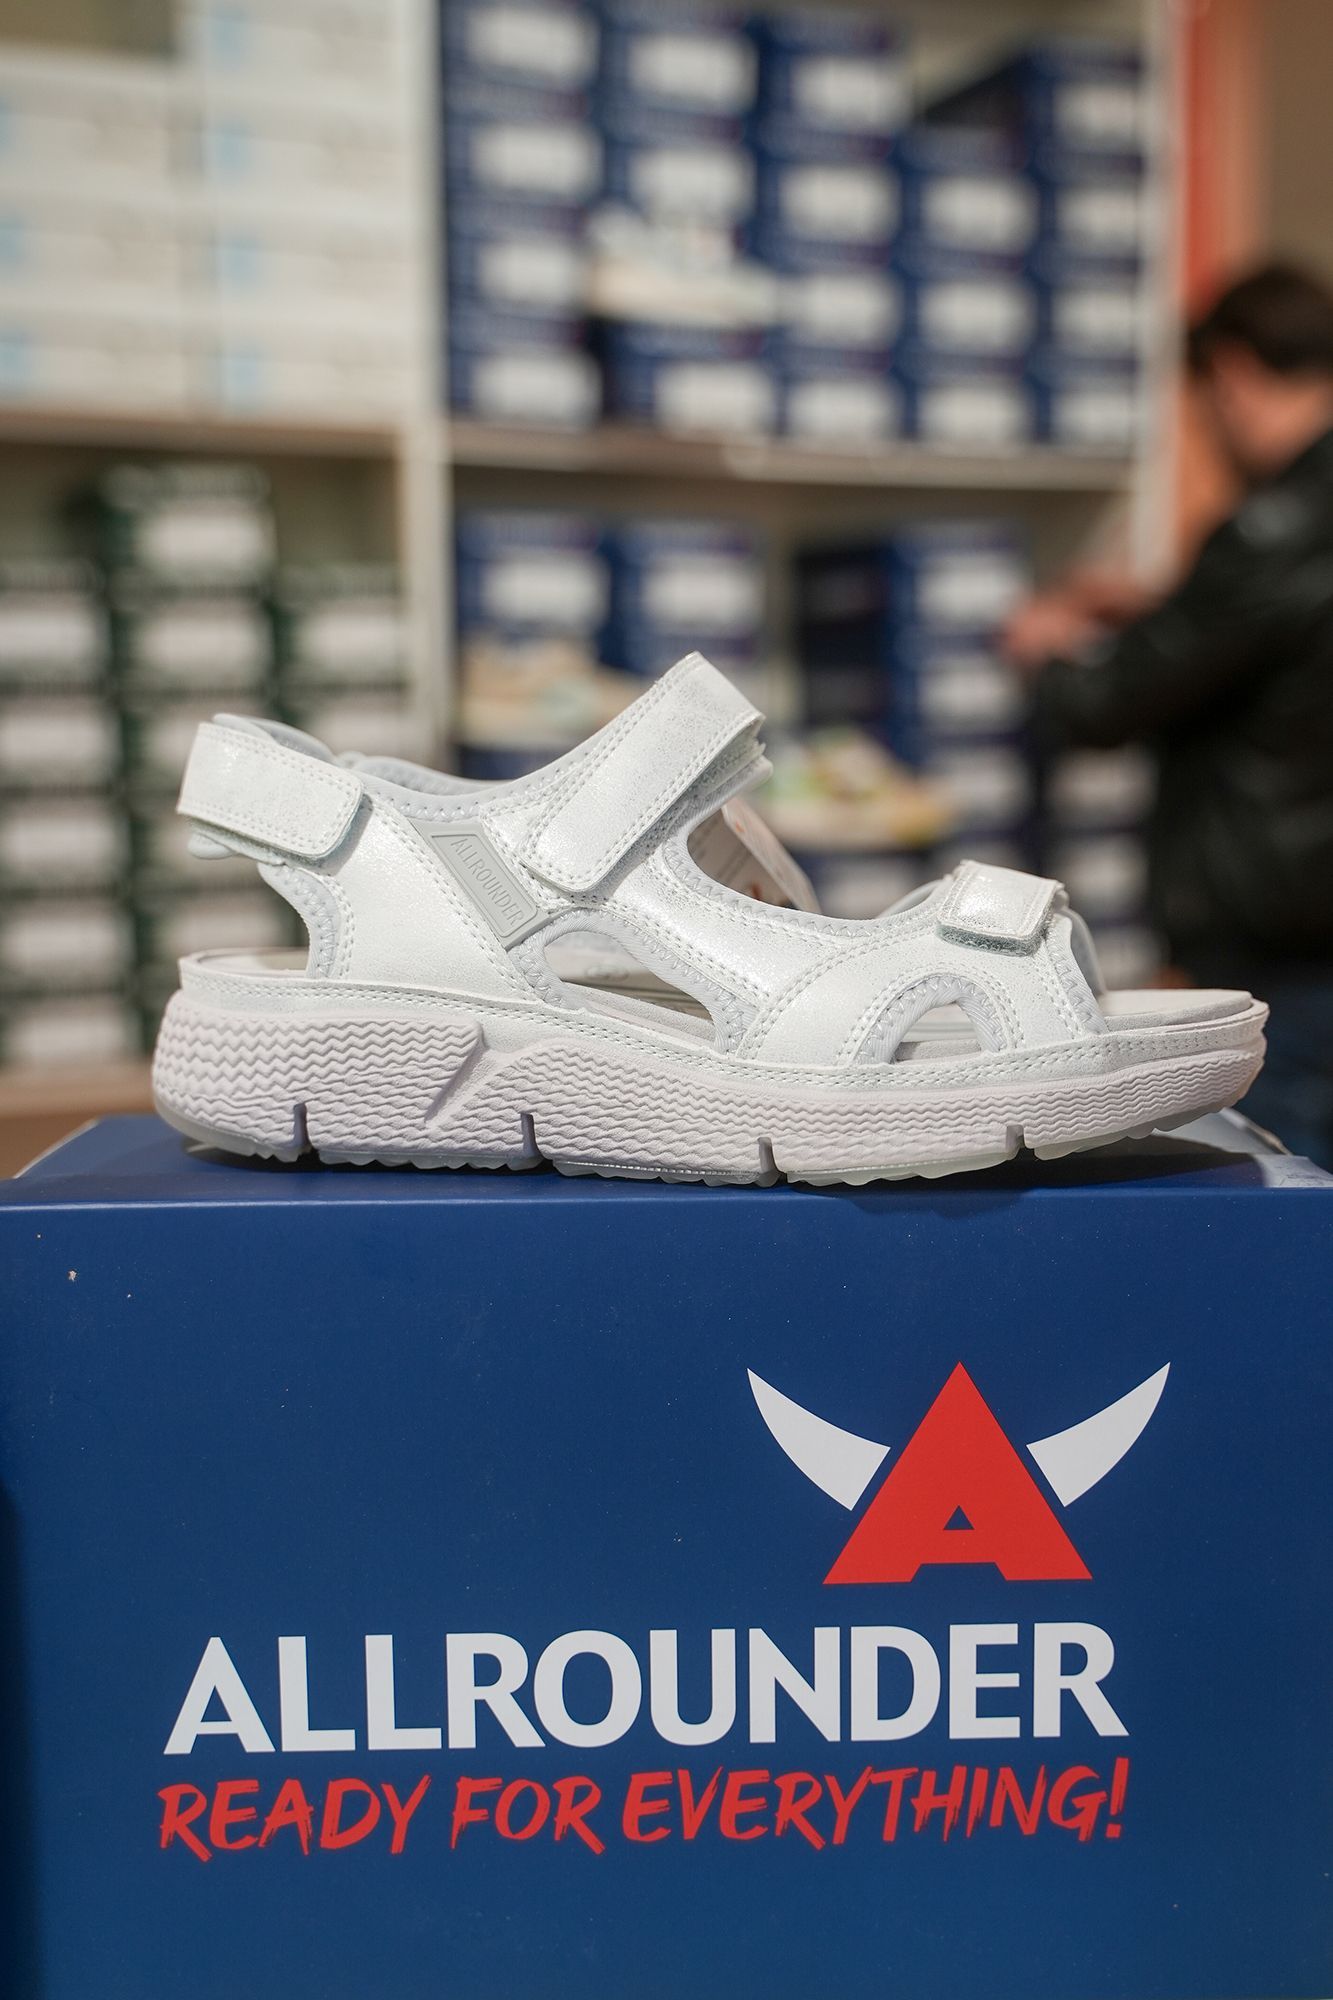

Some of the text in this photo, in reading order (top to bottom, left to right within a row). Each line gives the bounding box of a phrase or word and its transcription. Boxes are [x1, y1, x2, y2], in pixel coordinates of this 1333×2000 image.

[451, 838, 524, 925] ALLROUNDER
[163, 1622, 1128, 1754] ALLROUNDER
[157, 1757, 1129, 1861] READY FOR EVERYTHING!
